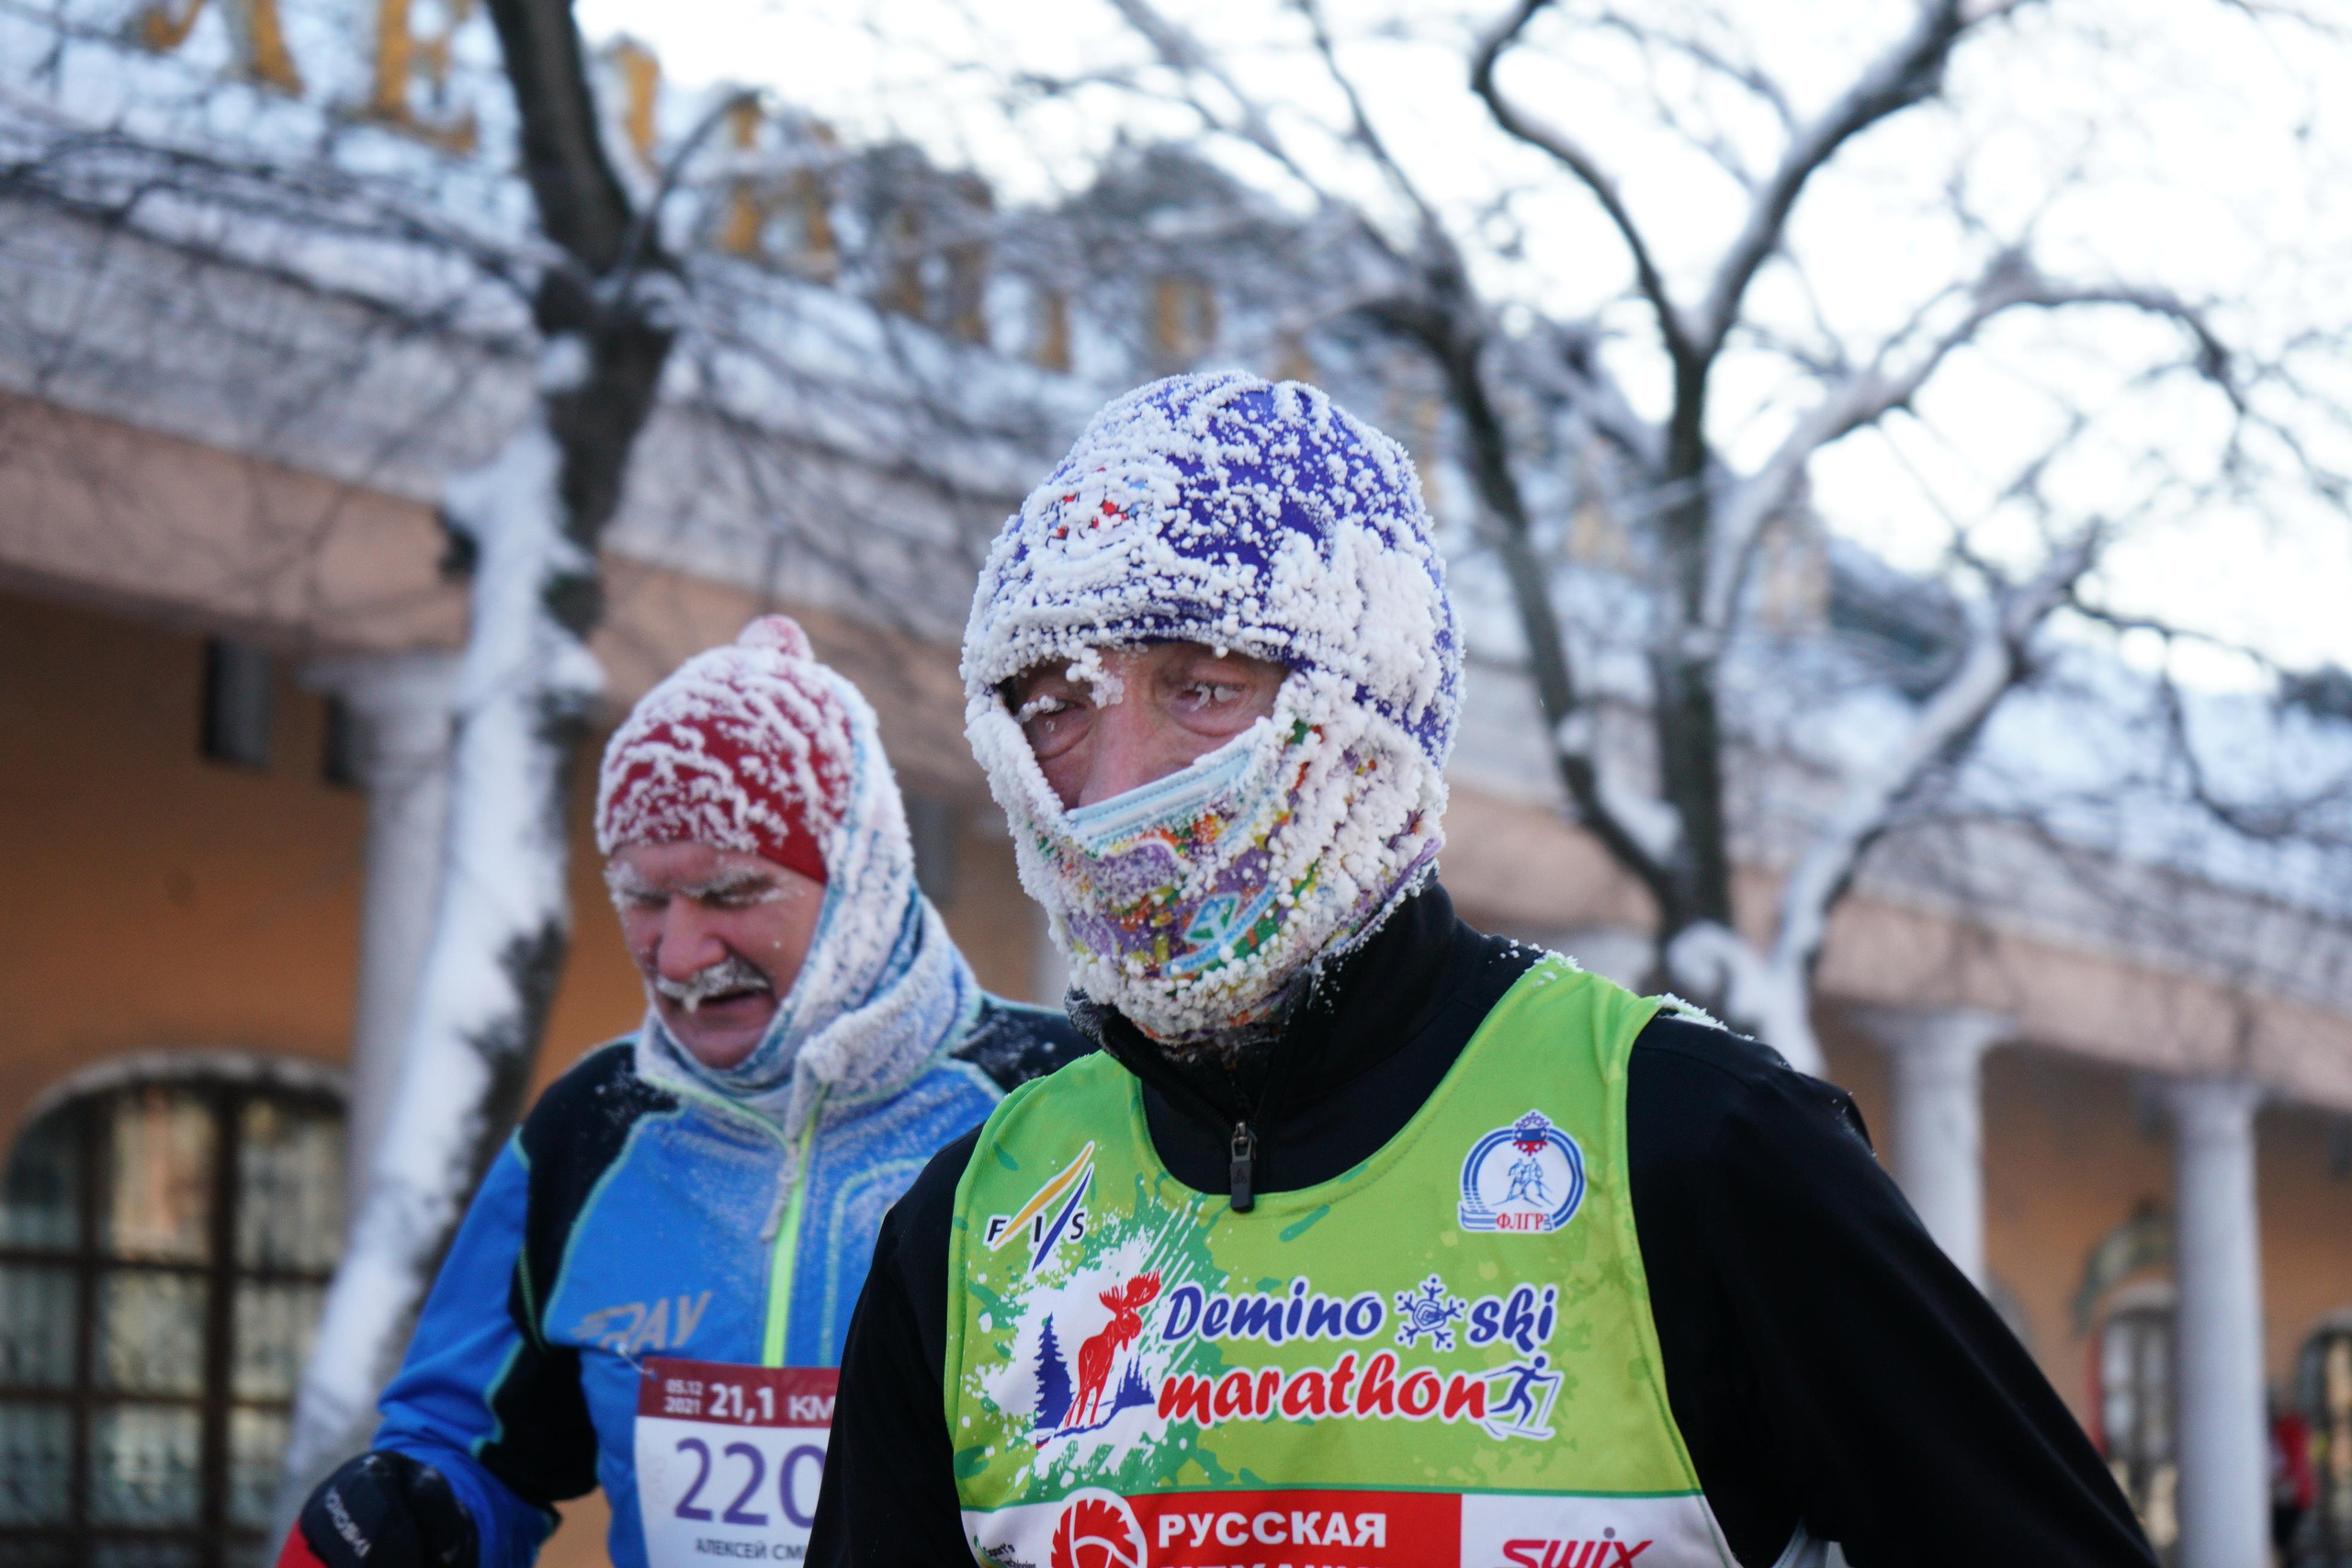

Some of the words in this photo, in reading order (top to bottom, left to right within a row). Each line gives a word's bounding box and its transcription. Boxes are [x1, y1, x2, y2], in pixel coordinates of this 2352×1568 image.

[987, 1211, 1085, 1243] FIS
[1496, 1212, 1544, 1231] ФЛГР
[1161, 1280, 1383, 1342] Demino
[1469, 1288, 1555, 1353] ski
[708, 1383, 775, 1424] 21,1
[1157, 1352, 1487, 1425] marathon
[673, 1436, 828, 1529] 220
[695, 1537, 768, 1559] АЛЕКСЕЙ
[1158, 1510, 1386, 1548] РУССКАЯ
